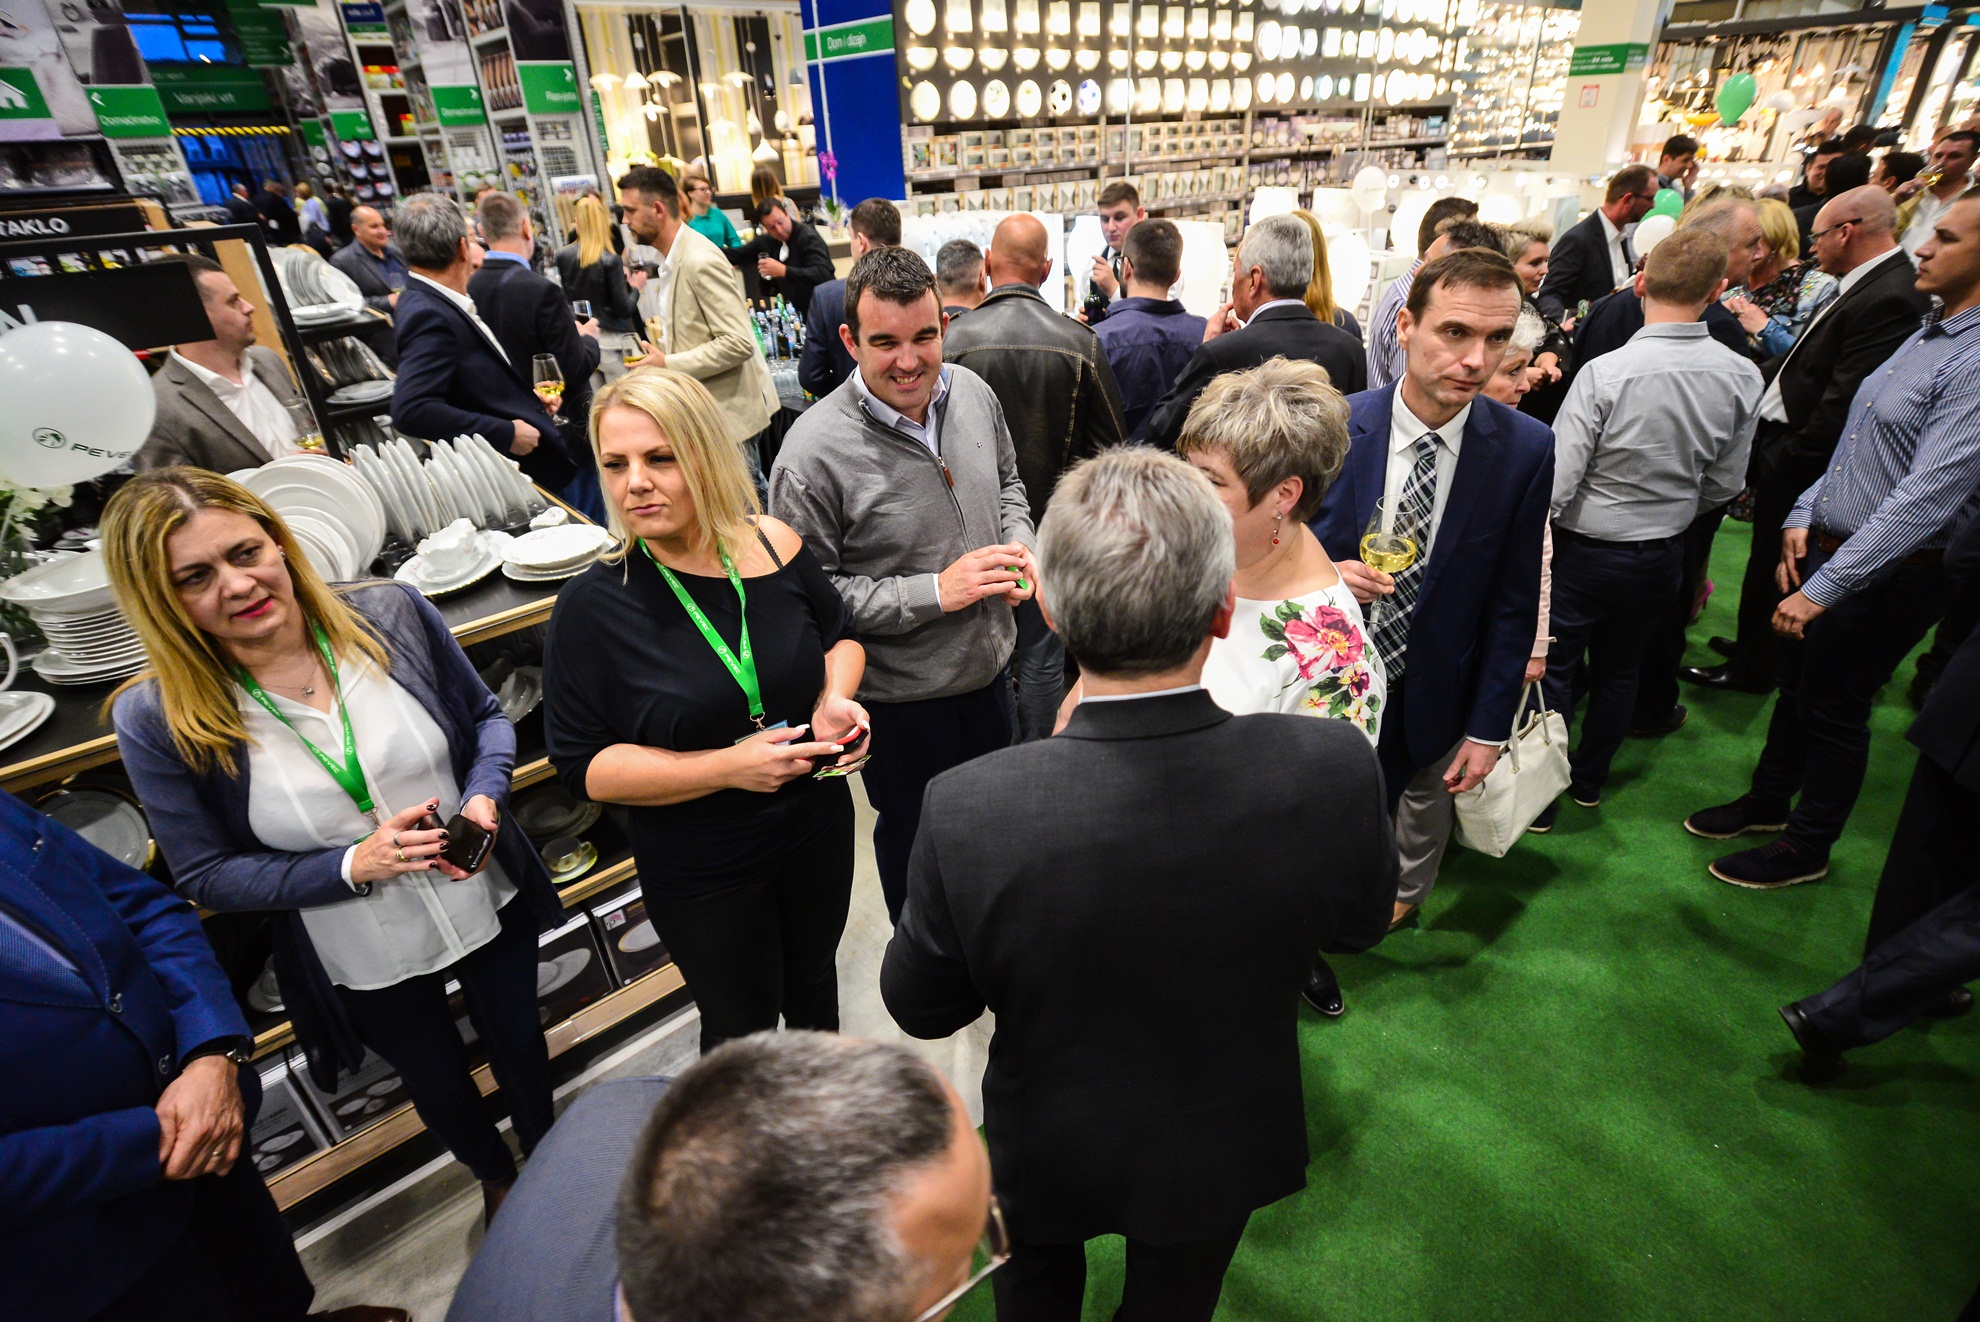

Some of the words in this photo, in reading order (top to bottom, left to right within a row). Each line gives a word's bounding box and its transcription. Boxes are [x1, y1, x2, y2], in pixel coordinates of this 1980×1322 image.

[827, 36, 842, 51] Dom
[847, 32, 867, 48] dizajn
[663, 569, 679, 589] PEVEC
[693, 611, 710, 632] PEVEC
[724, 653, 741, 675] PEVEC
[319, 753, 340, 774] PEVEC
